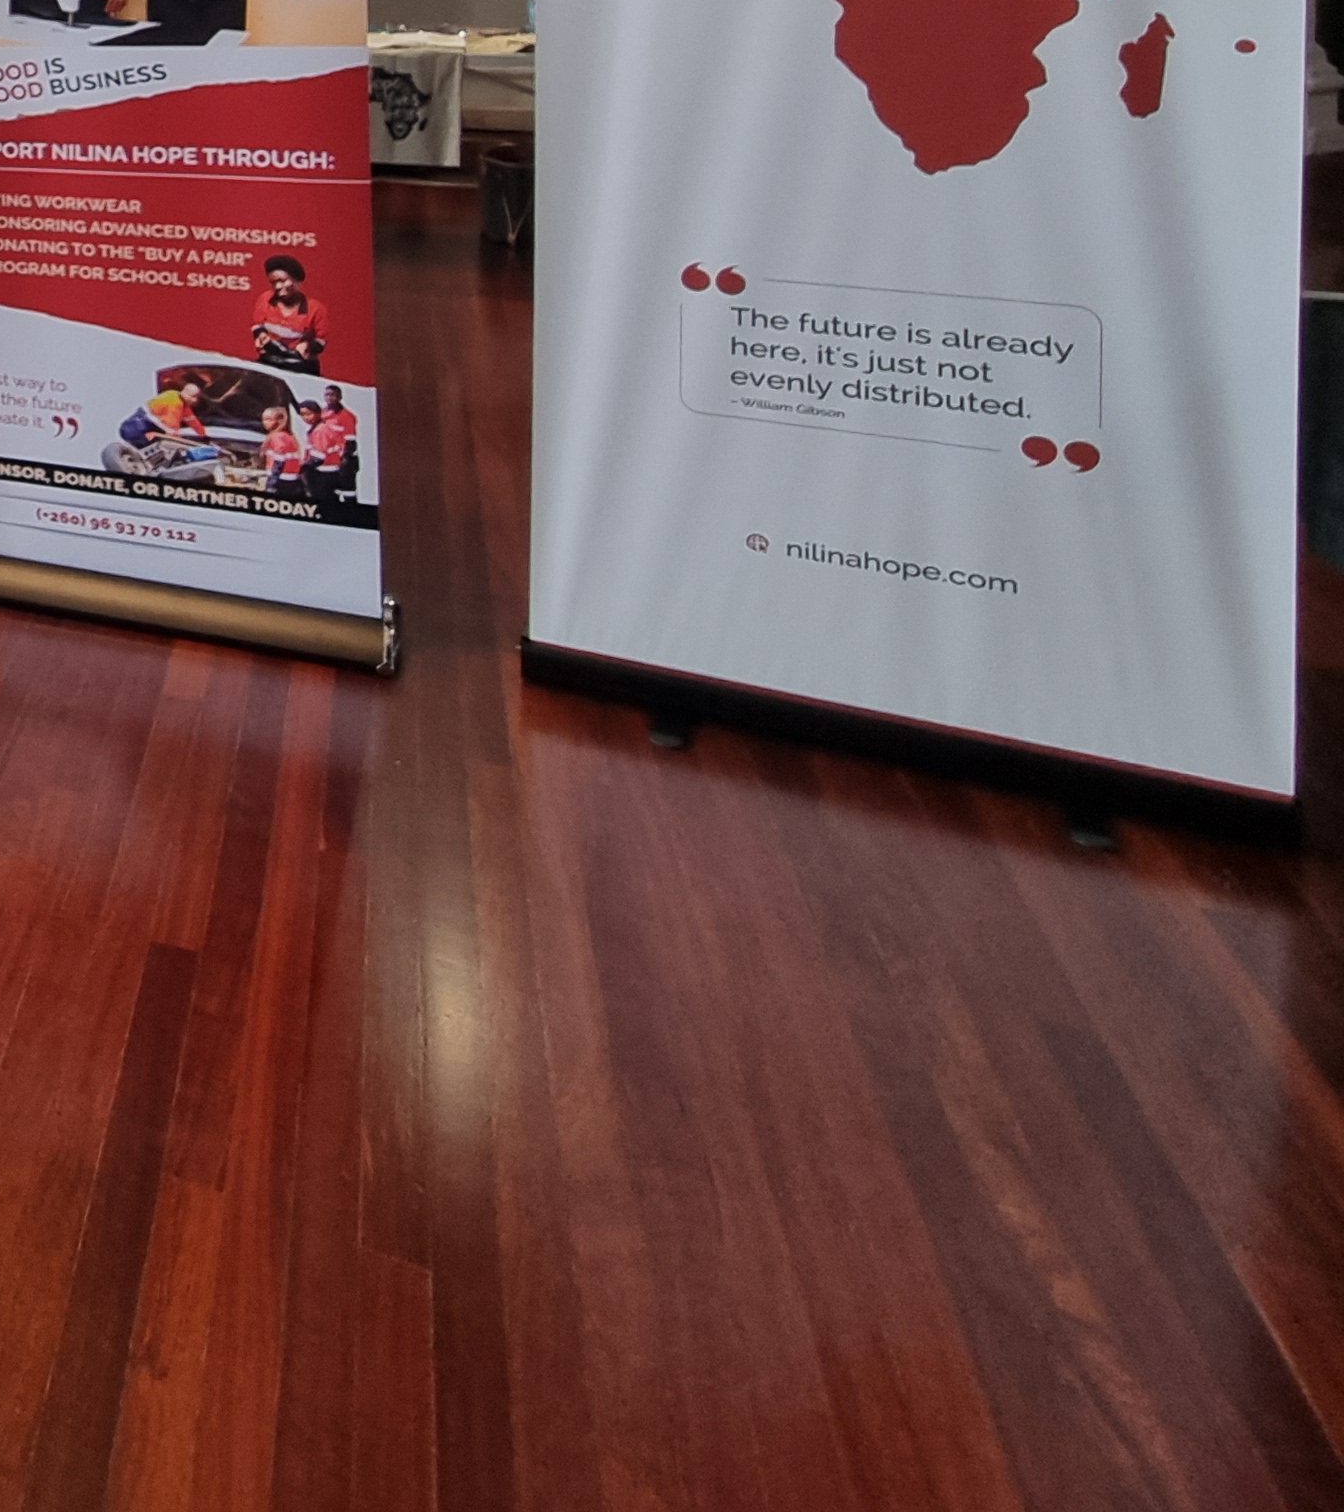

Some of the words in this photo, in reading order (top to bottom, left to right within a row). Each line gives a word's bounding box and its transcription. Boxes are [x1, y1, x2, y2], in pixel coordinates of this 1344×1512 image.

[43, 57, 65, 75] IS
[49, 63, 168, 96] BUSINESS
[51, 143, 128, 165] NILINA
[132, 145, 198, 166] HOPE
[202, 147, 336, 171] THROUGH:
[34, 194, 142, 214] WORKWEAR
[89, 220, 187, 241] ADVANCED
[190, 225, 317, 247] WORKSHOPS
[73, 242, 96, 258] TO
[98, 243, 135, 261] THE
[186, 249, 200, 265] A
[69, 265, 105, 282] FOR
[107, 268, 185, 287] SCHOOL
[186, 273, 252, 291] SHOES
[729, 306, 790, 331] The
[799, 313, 898, 342] future
[907, 322, 932, 345] is
[941, 328, 1075, 364] already
[730, 335, 809, 365] here,
[817, 345, 859, 369] it's
[863, 351, 928, 377] just
[937, 360, 994, 384] not
[13, 376, 46, 394] way
[50, 378, 68, 393] to
[729, 368, 834, 400] evenly
[842, 379, 1032, 419] distributed.
[1, 393, 29, 409] the
[32, 394, 83, 414] future
[53, 468, 131, 496] DONATE,
[132, 479, 160, 498] OR
[162, 485, 249, 510] PARTNER
[251, 495, 323, 520] TODAY.
[36, 506, 87, 528] (+260)
[89, 516, 112, 531] 96
[115, 521, 138, 538] 93
[140, 525, 162, 539] 70
[165, 528, 198, 543] 112
[785, 538, 1020, 596] nilinahope.com
